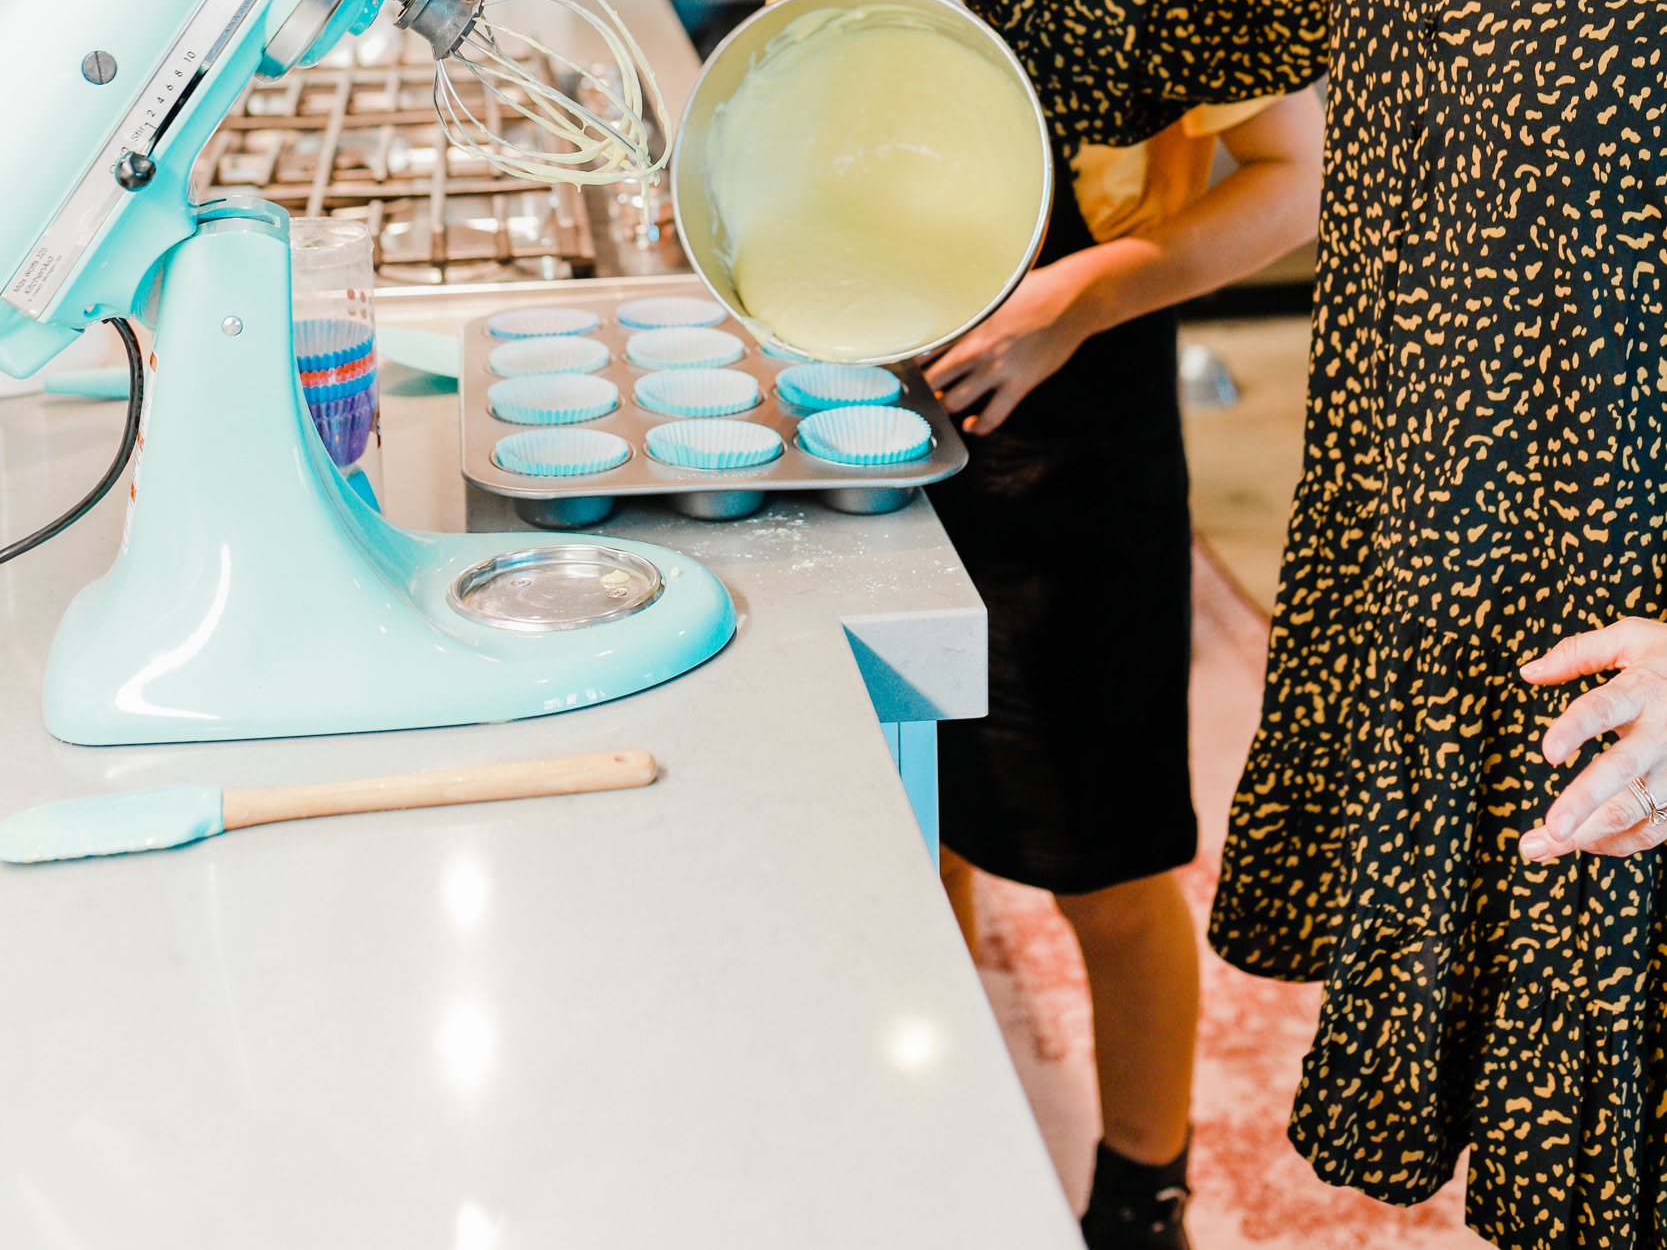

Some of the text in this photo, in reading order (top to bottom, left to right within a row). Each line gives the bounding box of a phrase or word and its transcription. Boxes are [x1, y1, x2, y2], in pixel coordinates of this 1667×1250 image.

[146, 109, 156, 118] 2
[157, 96, 165, 104] 4
[175, 69, 184, 78] 8
[183, 50, 196, 63] 10
